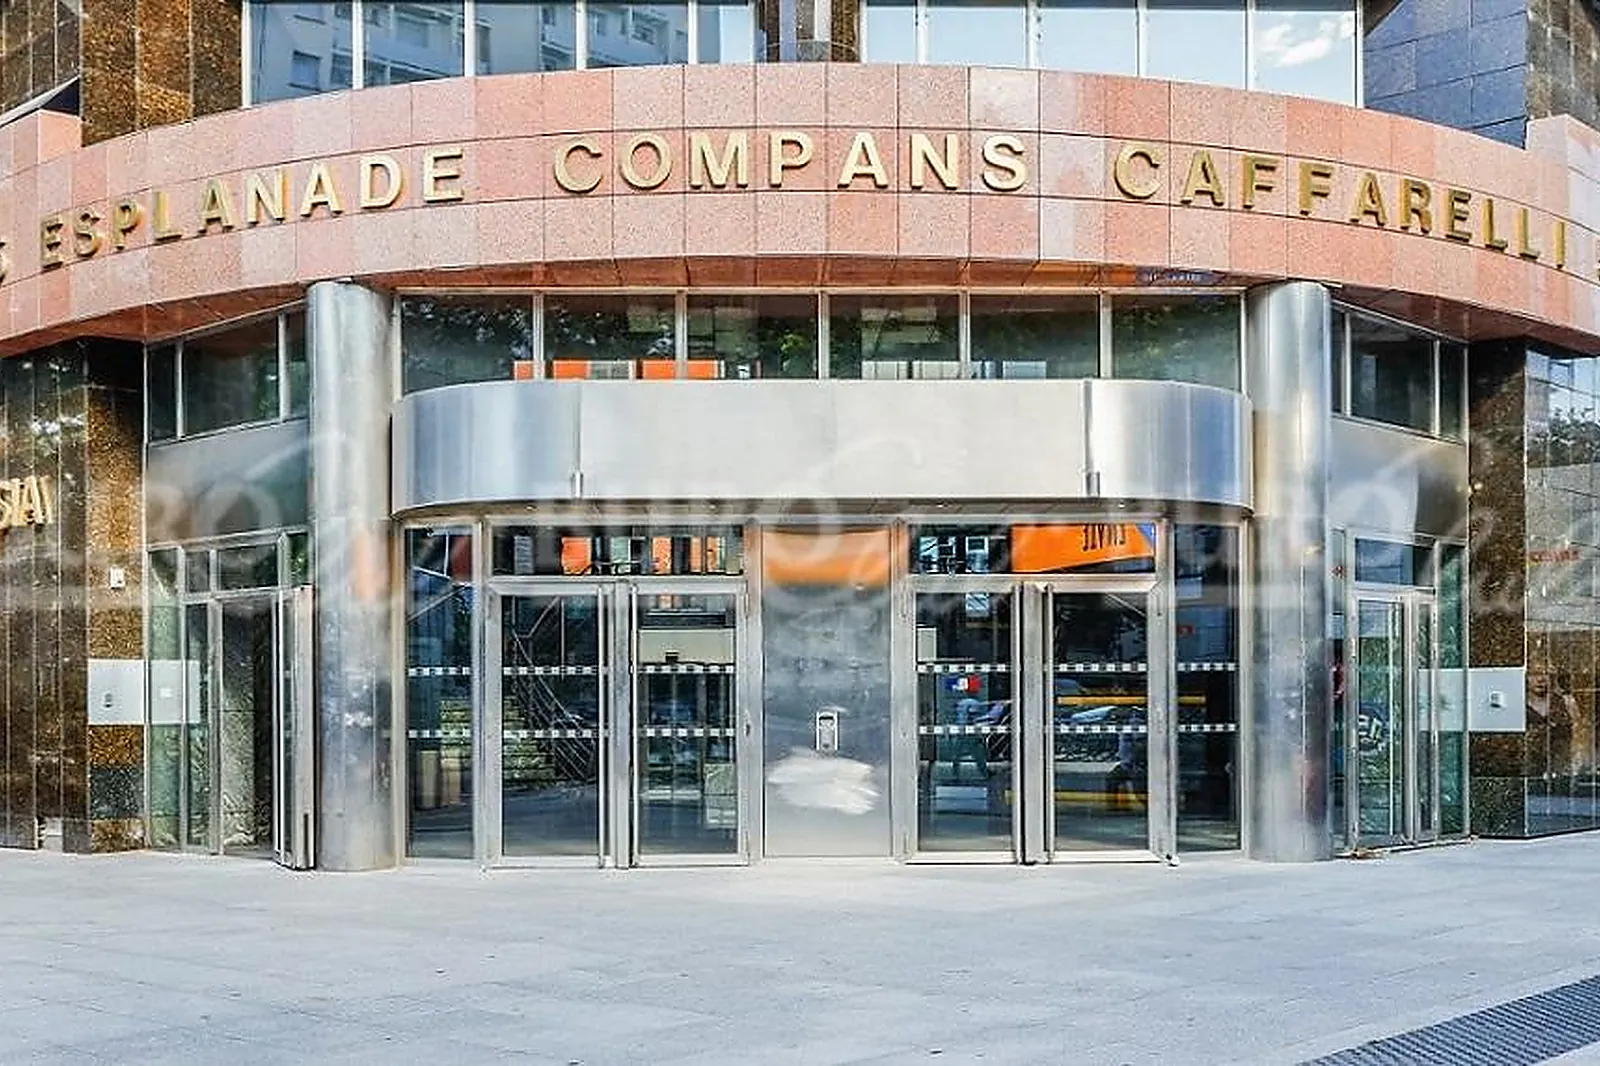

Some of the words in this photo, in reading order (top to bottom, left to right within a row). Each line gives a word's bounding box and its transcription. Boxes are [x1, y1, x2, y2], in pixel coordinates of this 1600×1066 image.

[40, 147, 466, 270] ESPLANADE
[553, 131, 1029, 193] COMPANS
[1113, 142, 1566, 268] CAFFARELLI
